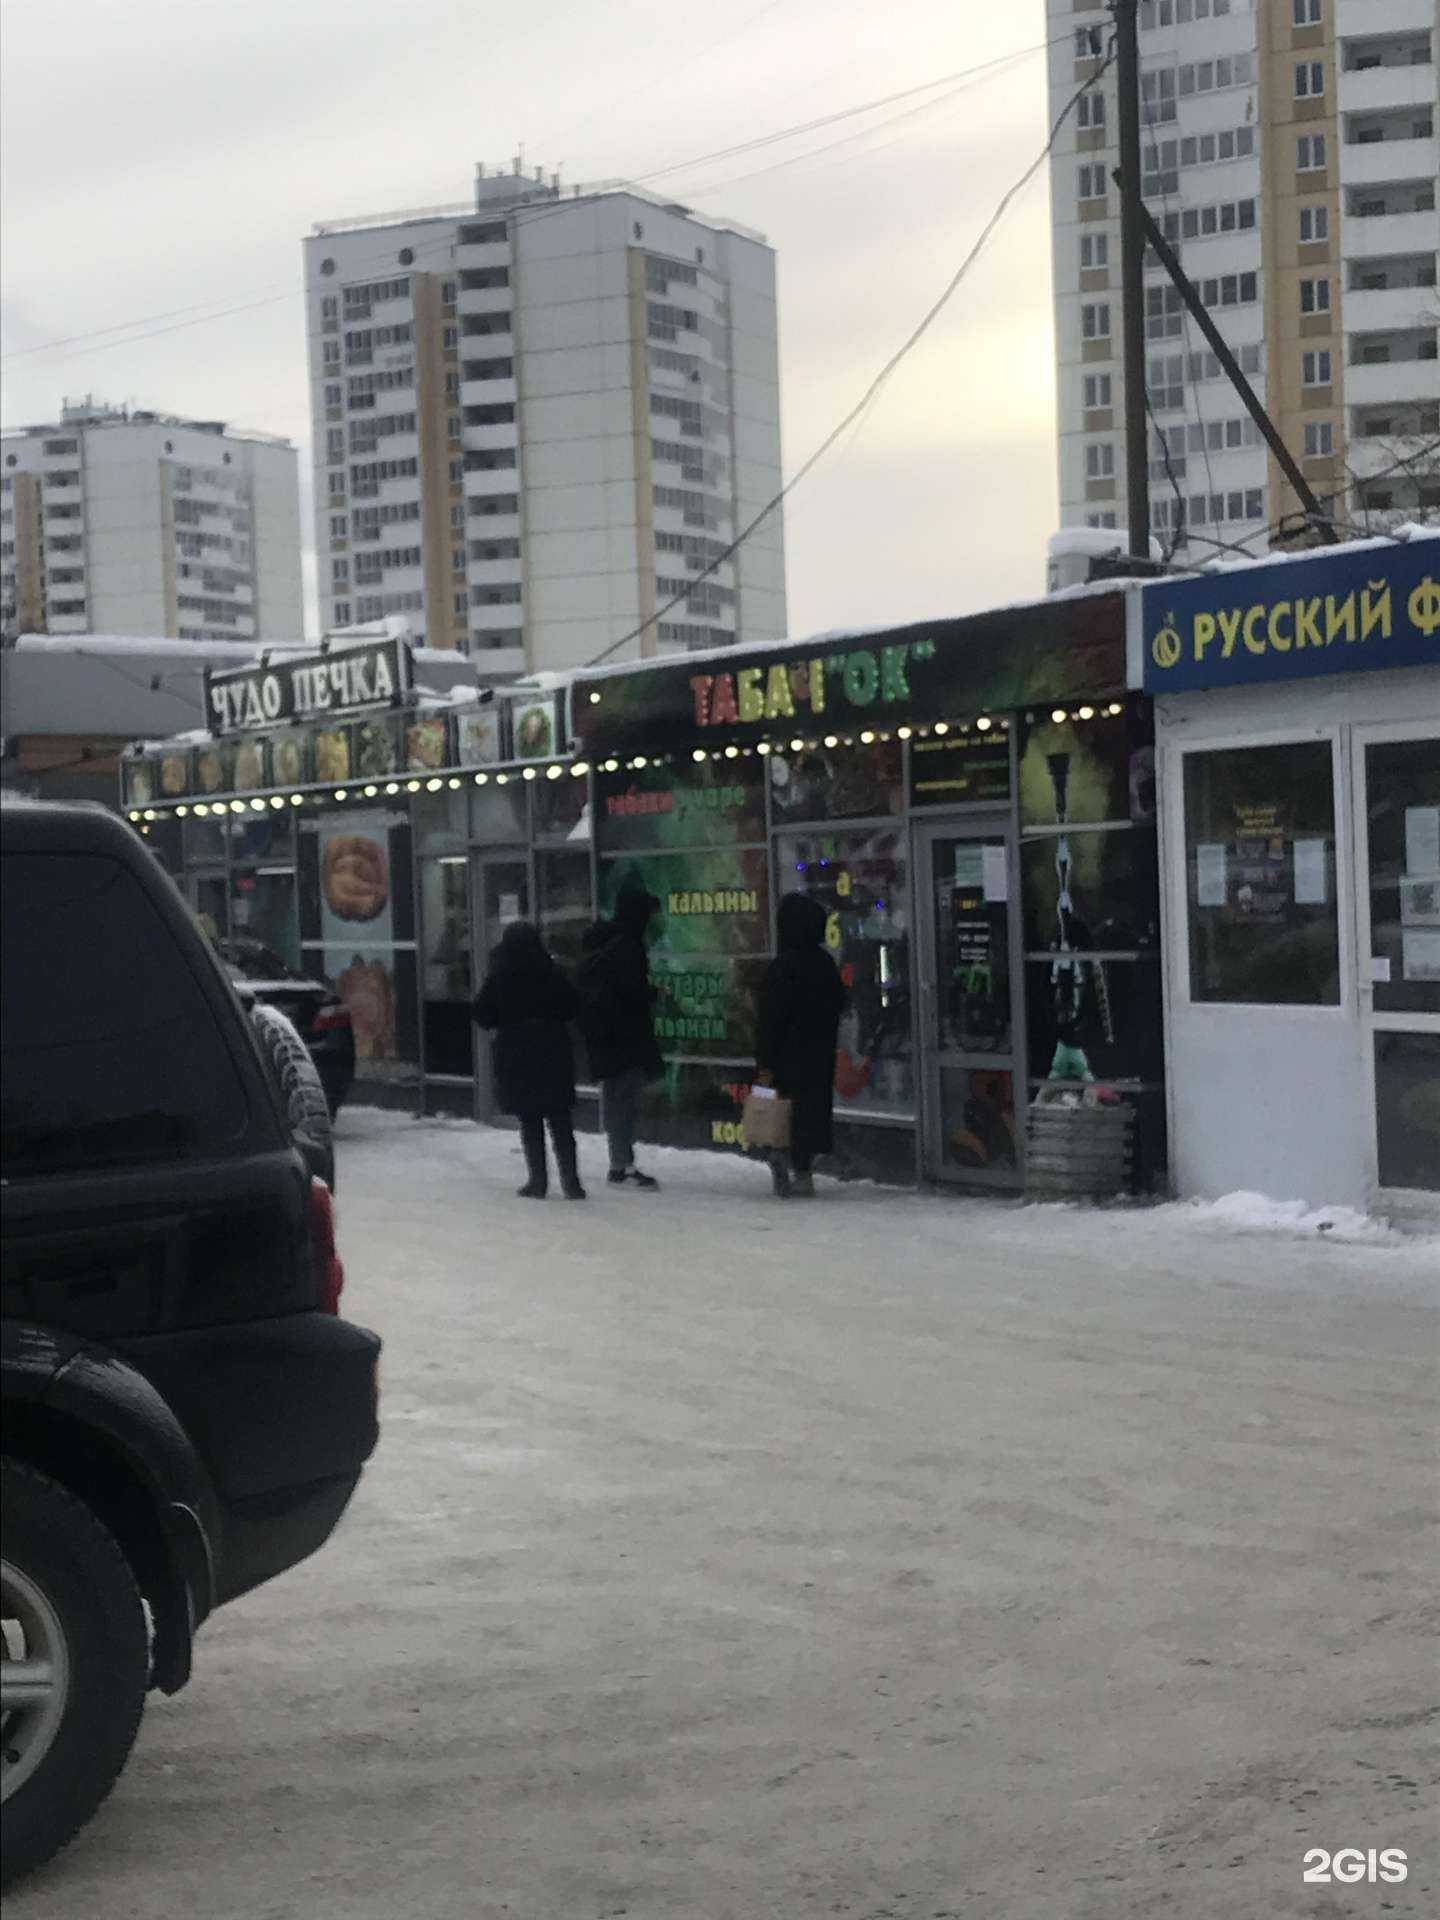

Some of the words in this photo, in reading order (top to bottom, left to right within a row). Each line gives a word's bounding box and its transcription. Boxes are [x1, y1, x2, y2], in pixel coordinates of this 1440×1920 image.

[1194, 578, 1392, 661] РУССКИЙ
[211, 675, 282, 731] ЧУДО
[292, 652, 393, 711] ПЕЧКА
